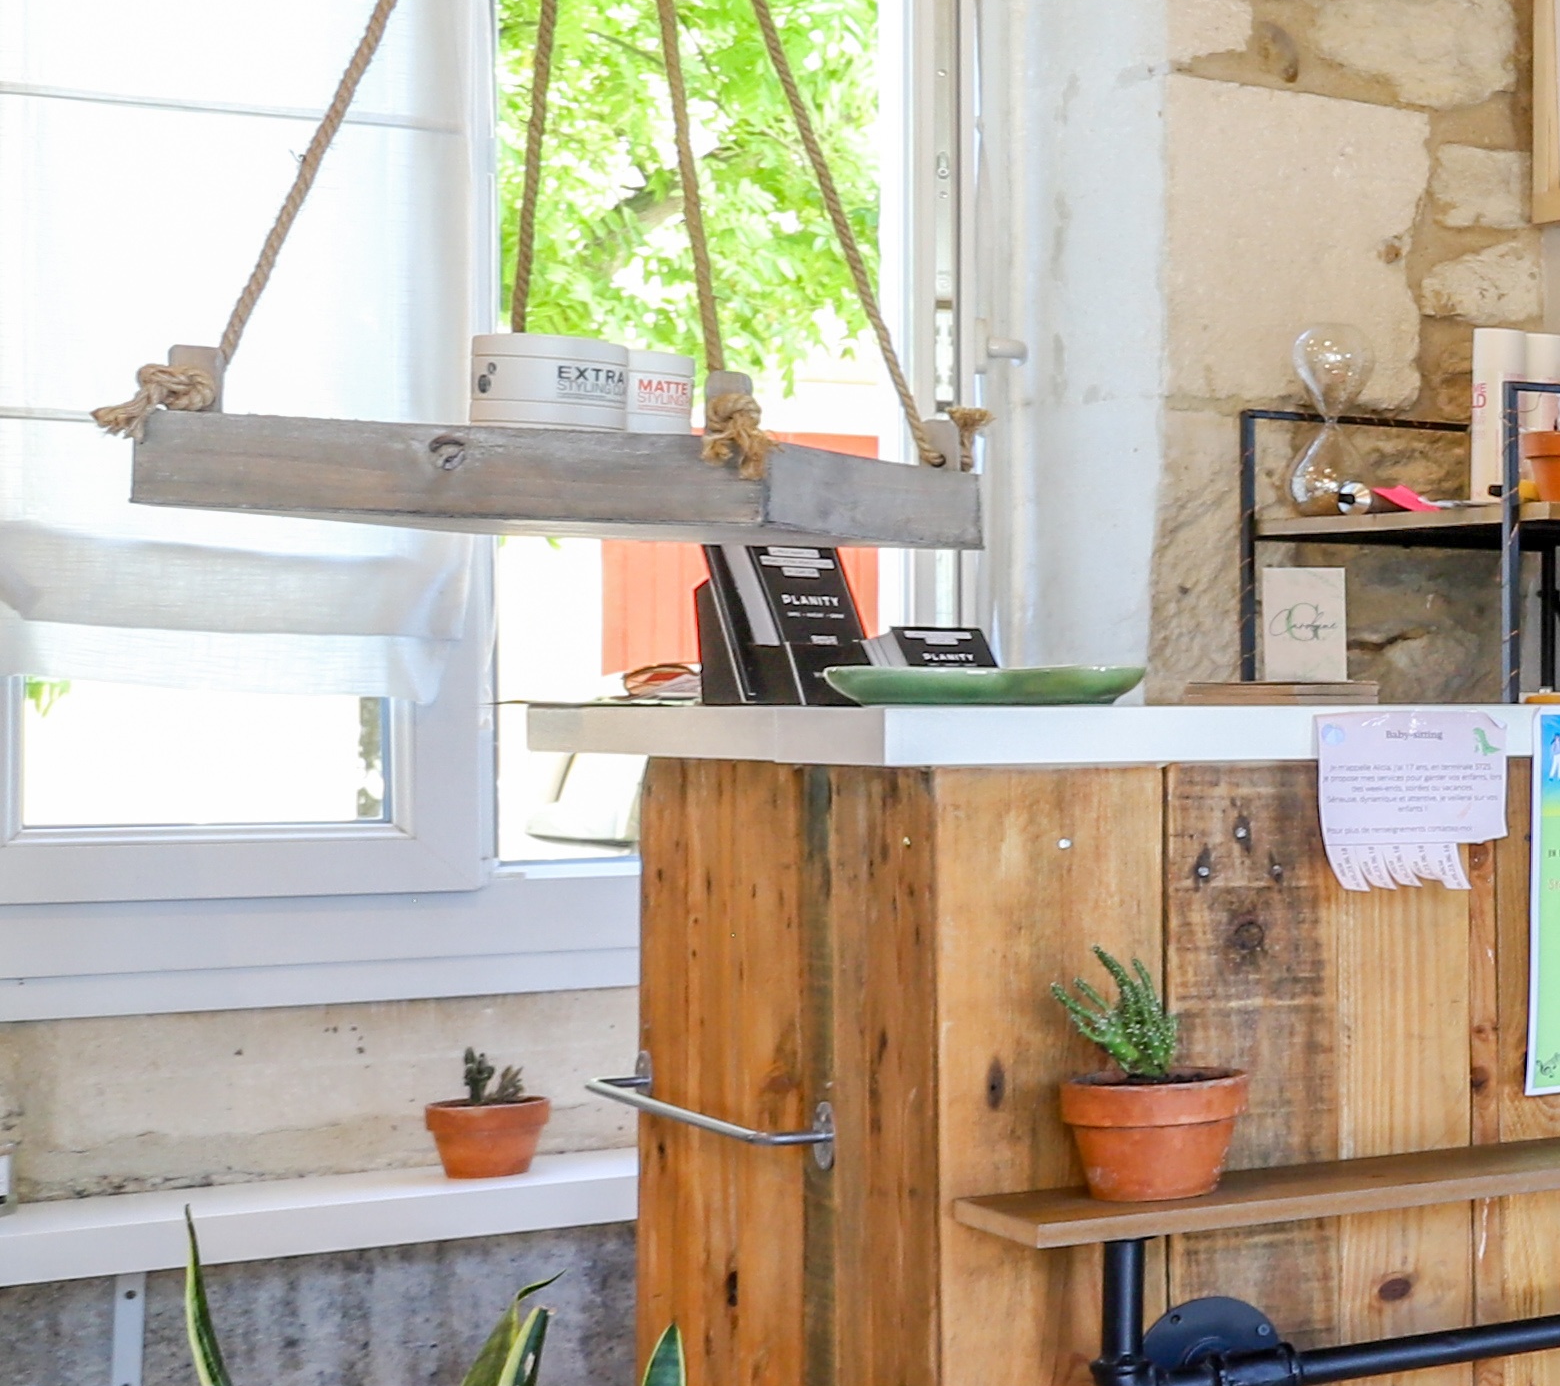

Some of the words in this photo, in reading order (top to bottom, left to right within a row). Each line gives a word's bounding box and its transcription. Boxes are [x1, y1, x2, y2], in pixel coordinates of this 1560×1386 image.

[558, 365, 624, 386] EXTRA
[556, 379, 612, 396] STYLING
[638, 378, 688, 396] MATTE
[782, 594, 839, 607] PLANITY
[922, 652, 974, 661] PLANITY
[1386, 731, 1443, 740] Baby-sitting
